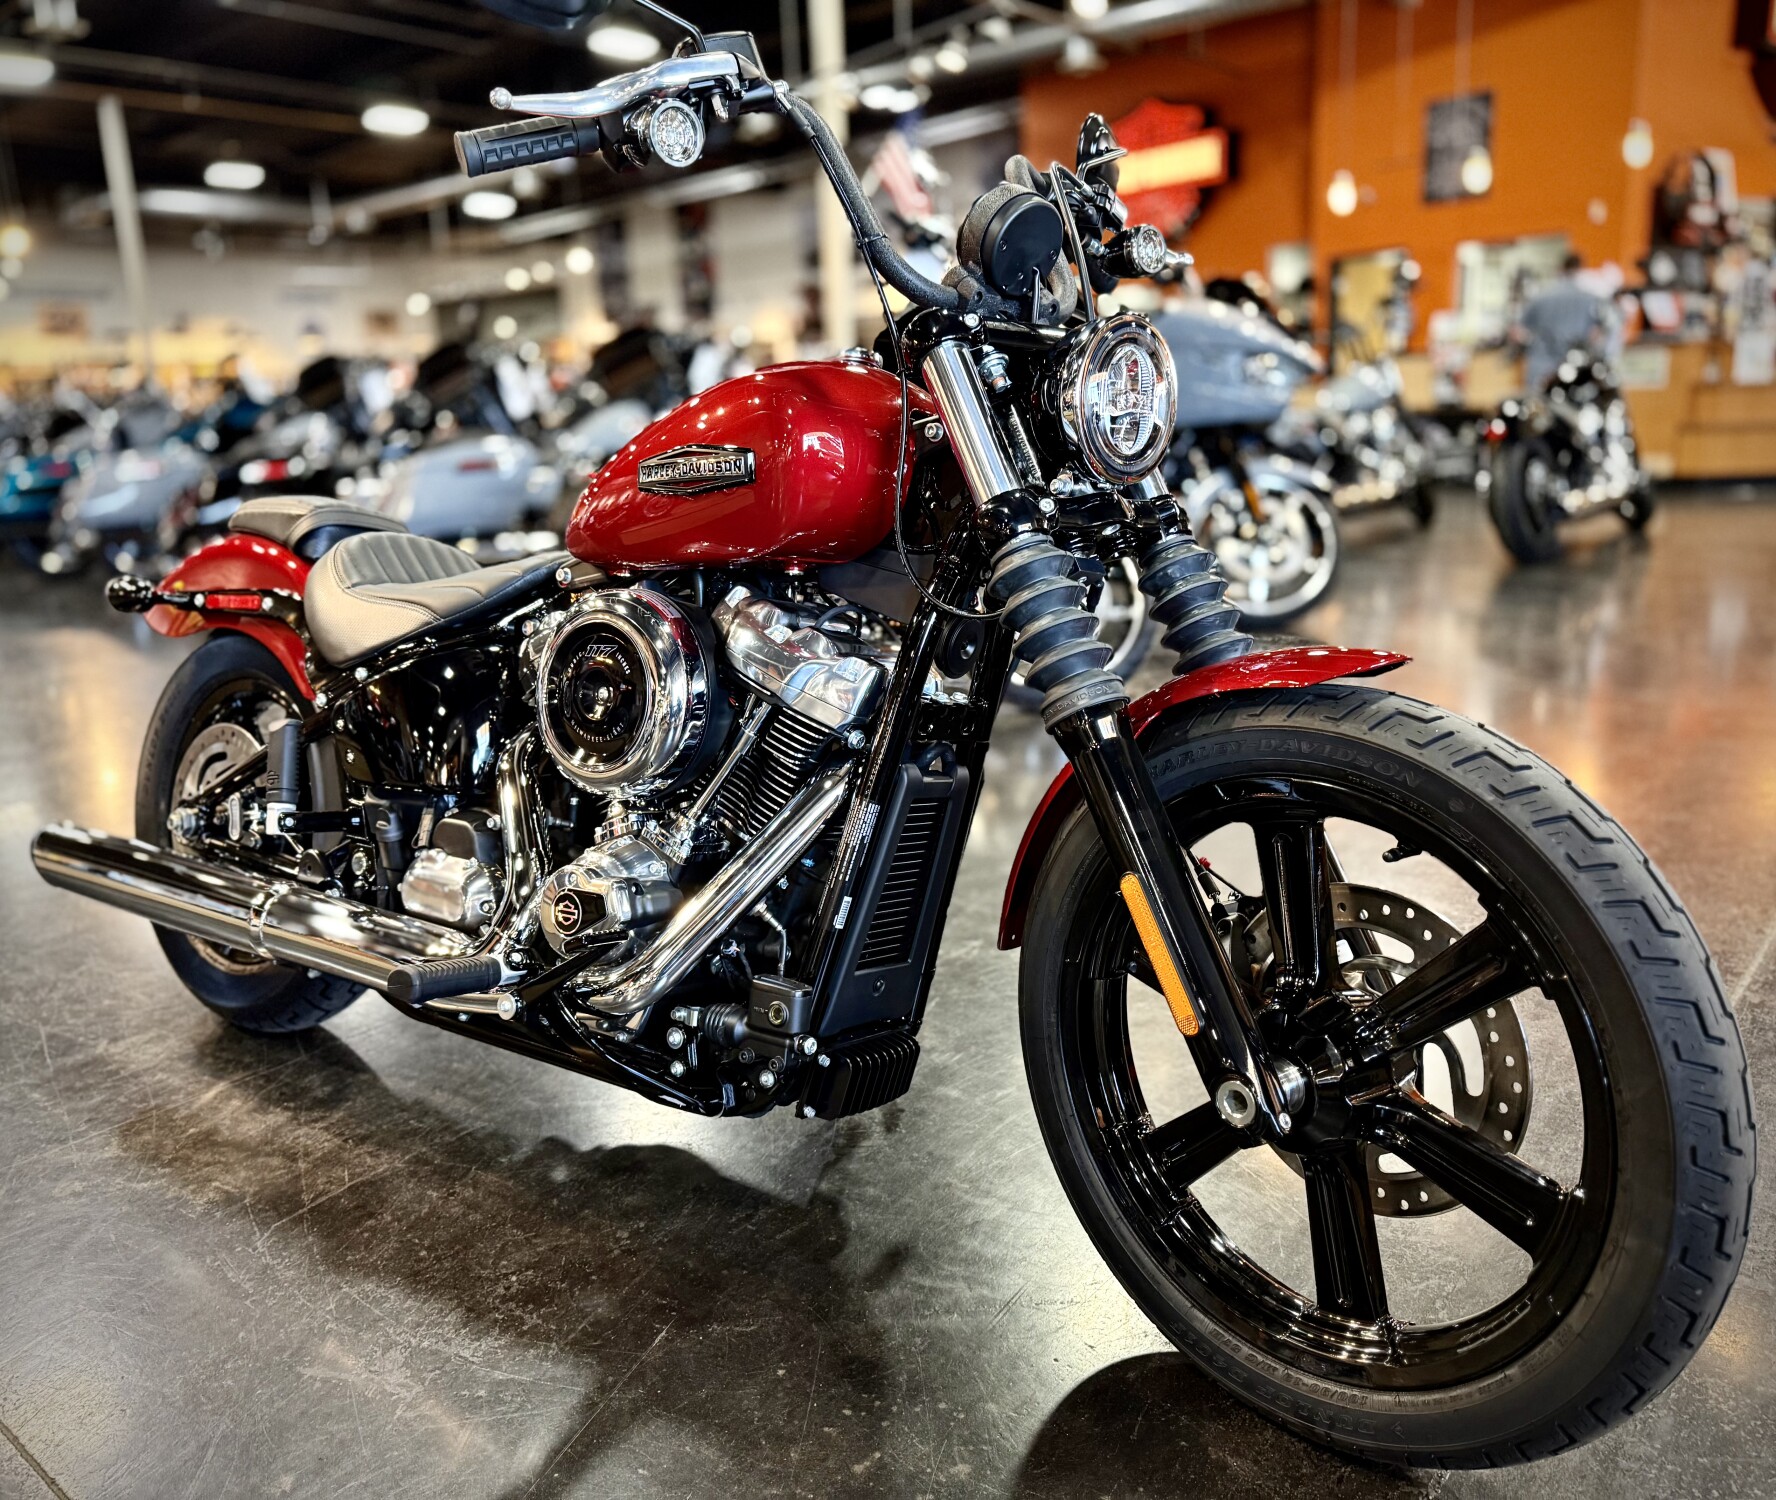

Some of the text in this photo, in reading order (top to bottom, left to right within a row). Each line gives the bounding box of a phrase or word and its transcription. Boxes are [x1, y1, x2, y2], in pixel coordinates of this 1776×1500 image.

[640, 458, 743, 482] HARLEY-DAVIDSON
[585, 644, 619, 657] 117
[615, 652, 631, 675] INCHES
[1258, 1384, 1376, 1433] DUNLOP
